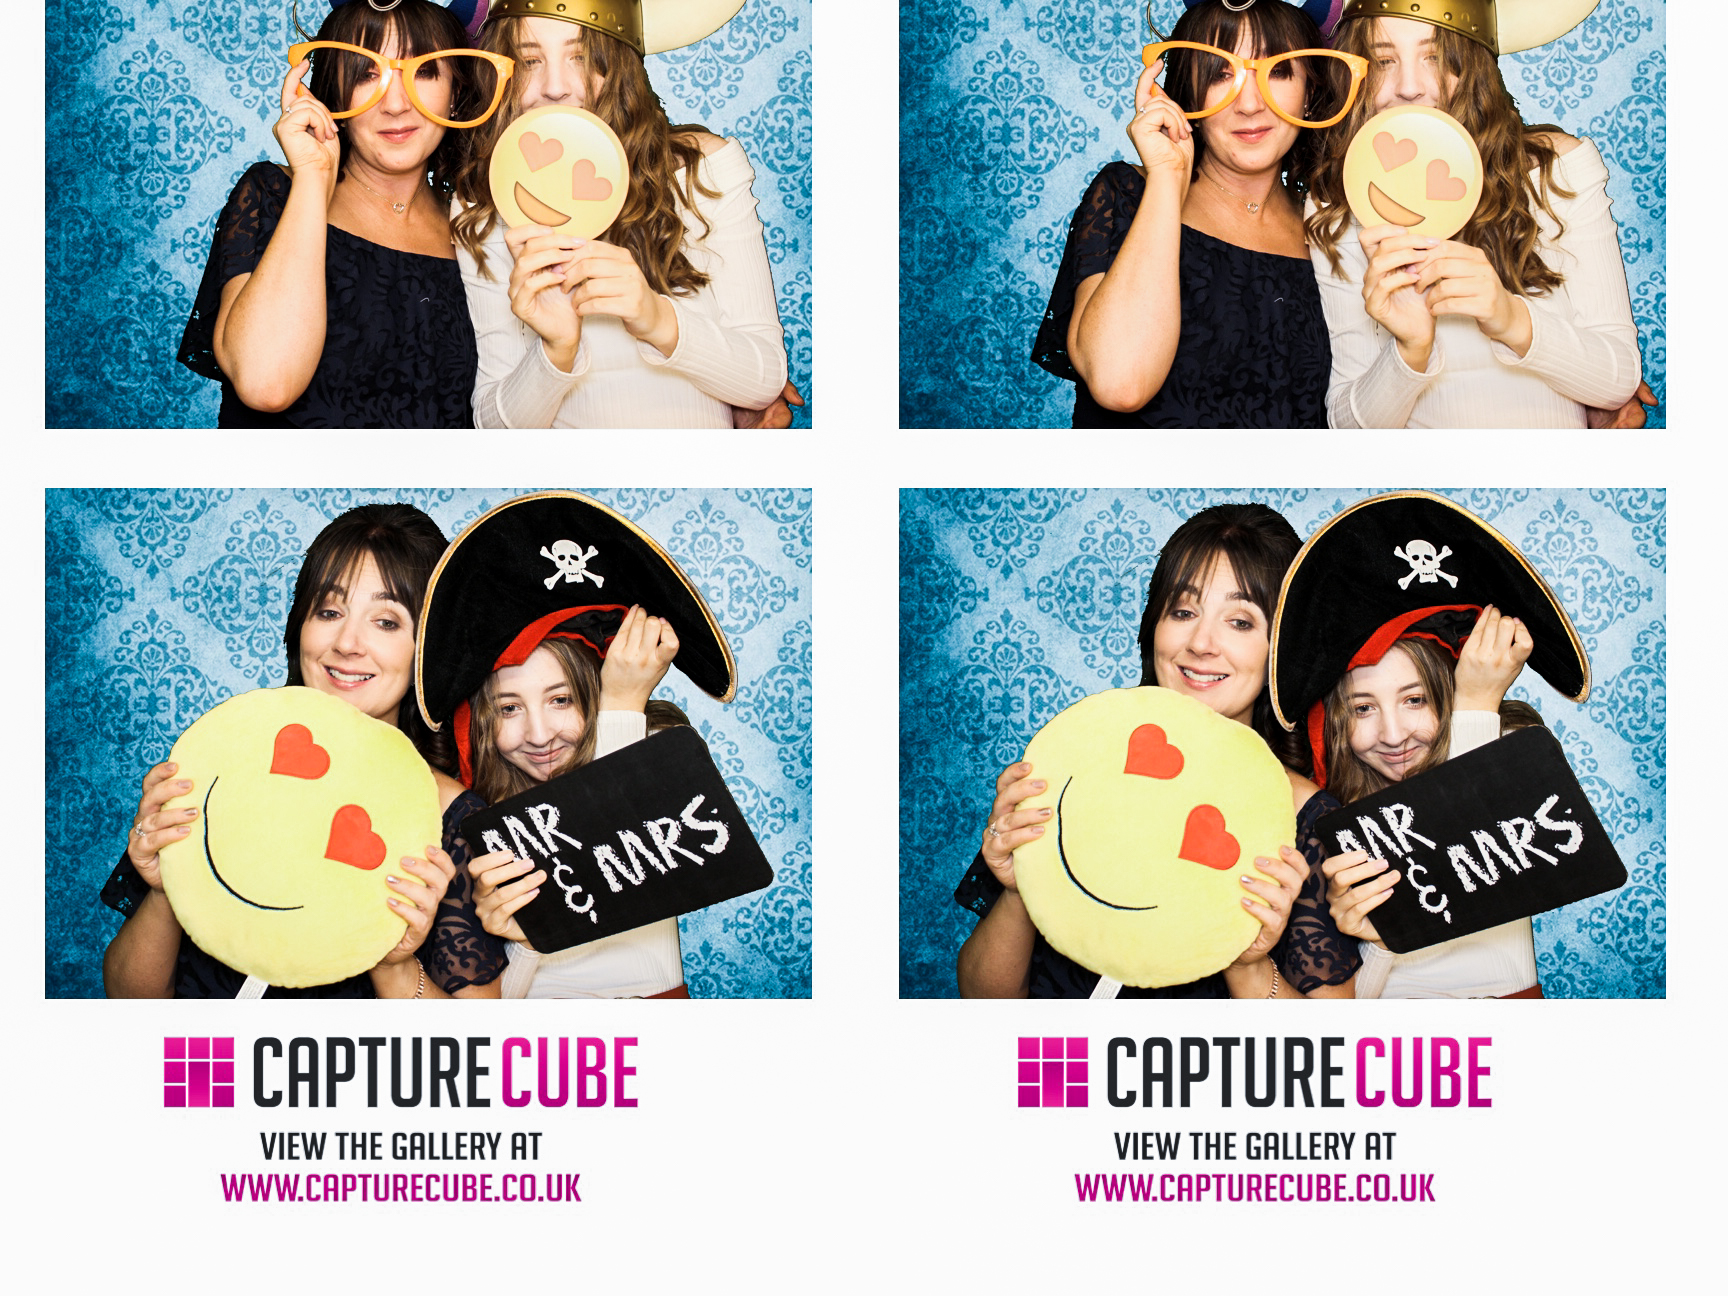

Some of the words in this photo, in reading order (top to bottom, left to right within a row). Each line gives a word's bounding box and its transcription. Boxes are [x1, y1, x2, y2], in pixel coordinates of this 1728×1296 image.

[481, 803, 583, 864] MR
[592, 793, 731, 893] MRS
[1335, 803, 1437, 864] MR
[1446, 793, 1585, 893] MRS
